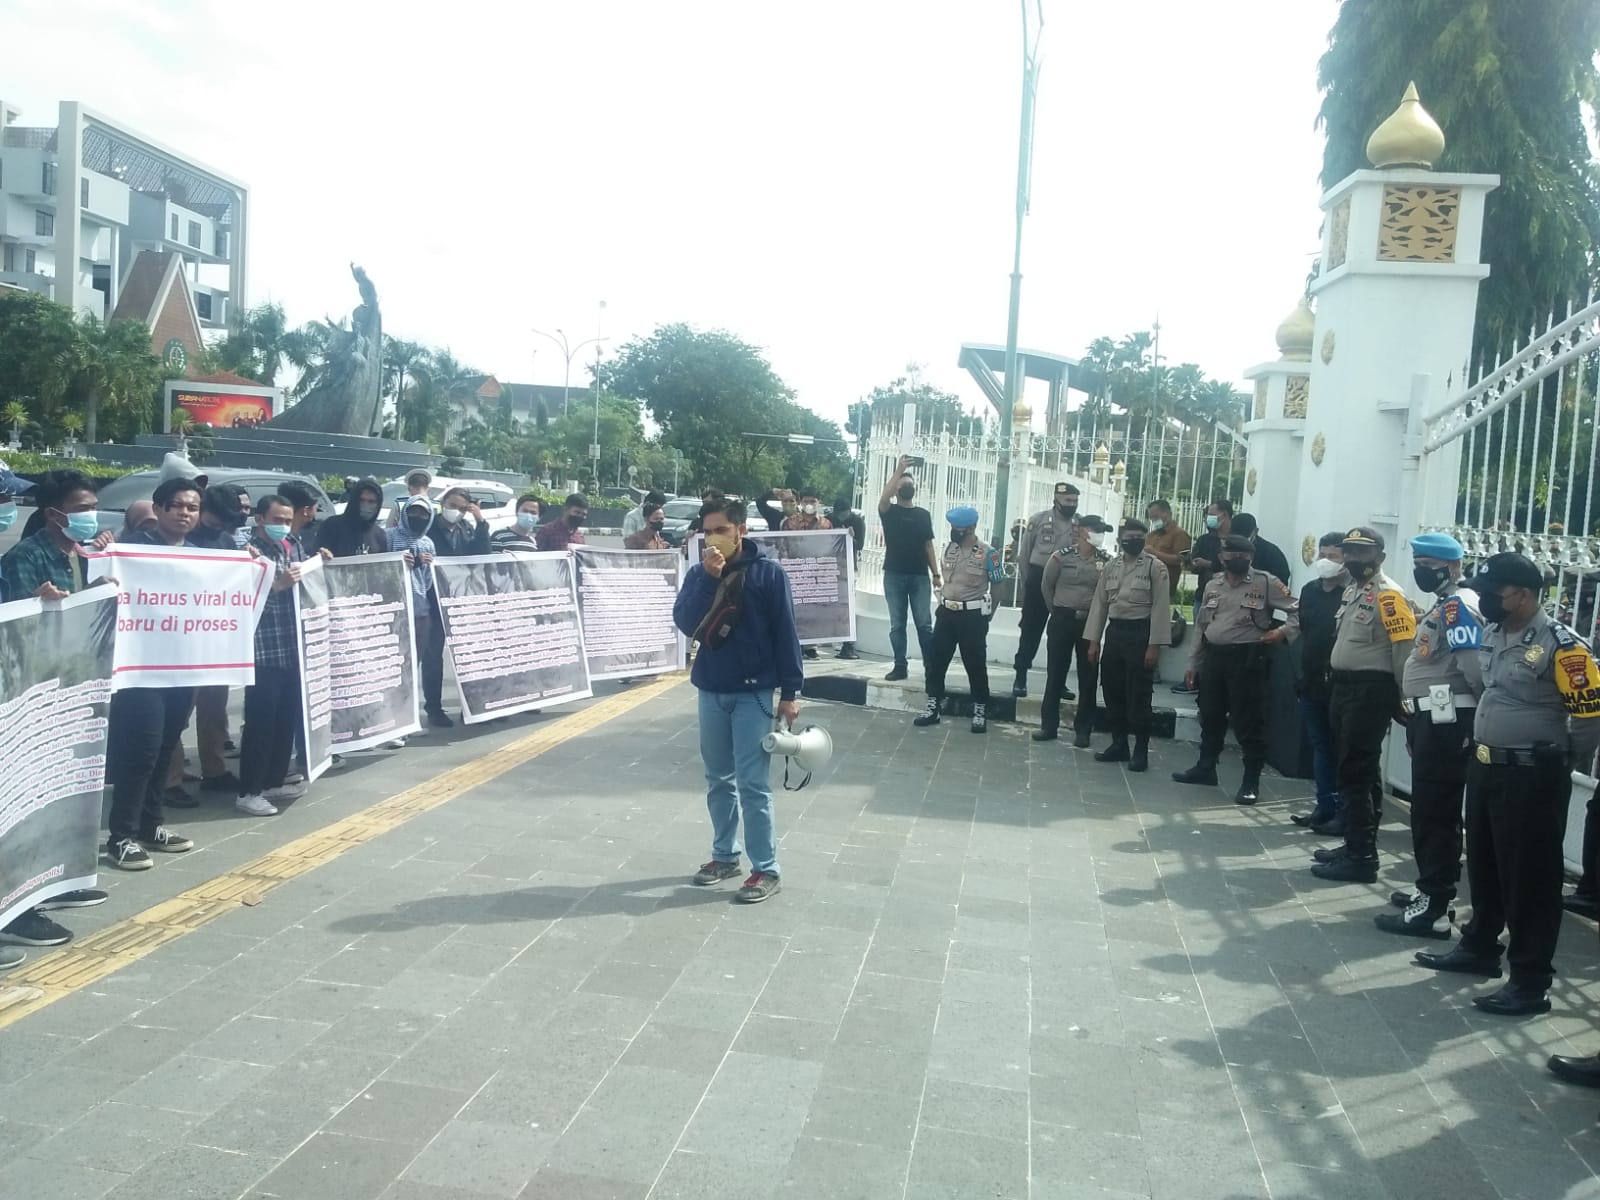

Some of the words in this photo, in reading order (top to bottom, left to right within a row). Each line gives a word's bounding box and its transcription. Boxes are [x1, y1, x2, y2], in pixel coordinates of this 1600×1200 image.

[137, 588, 187, 606] harus
[193, 590, 227, 606] viral
[118, 615, 154, 632] baru
[160, 615, 178, 632] di
[183, 618, 238, 635] proses
